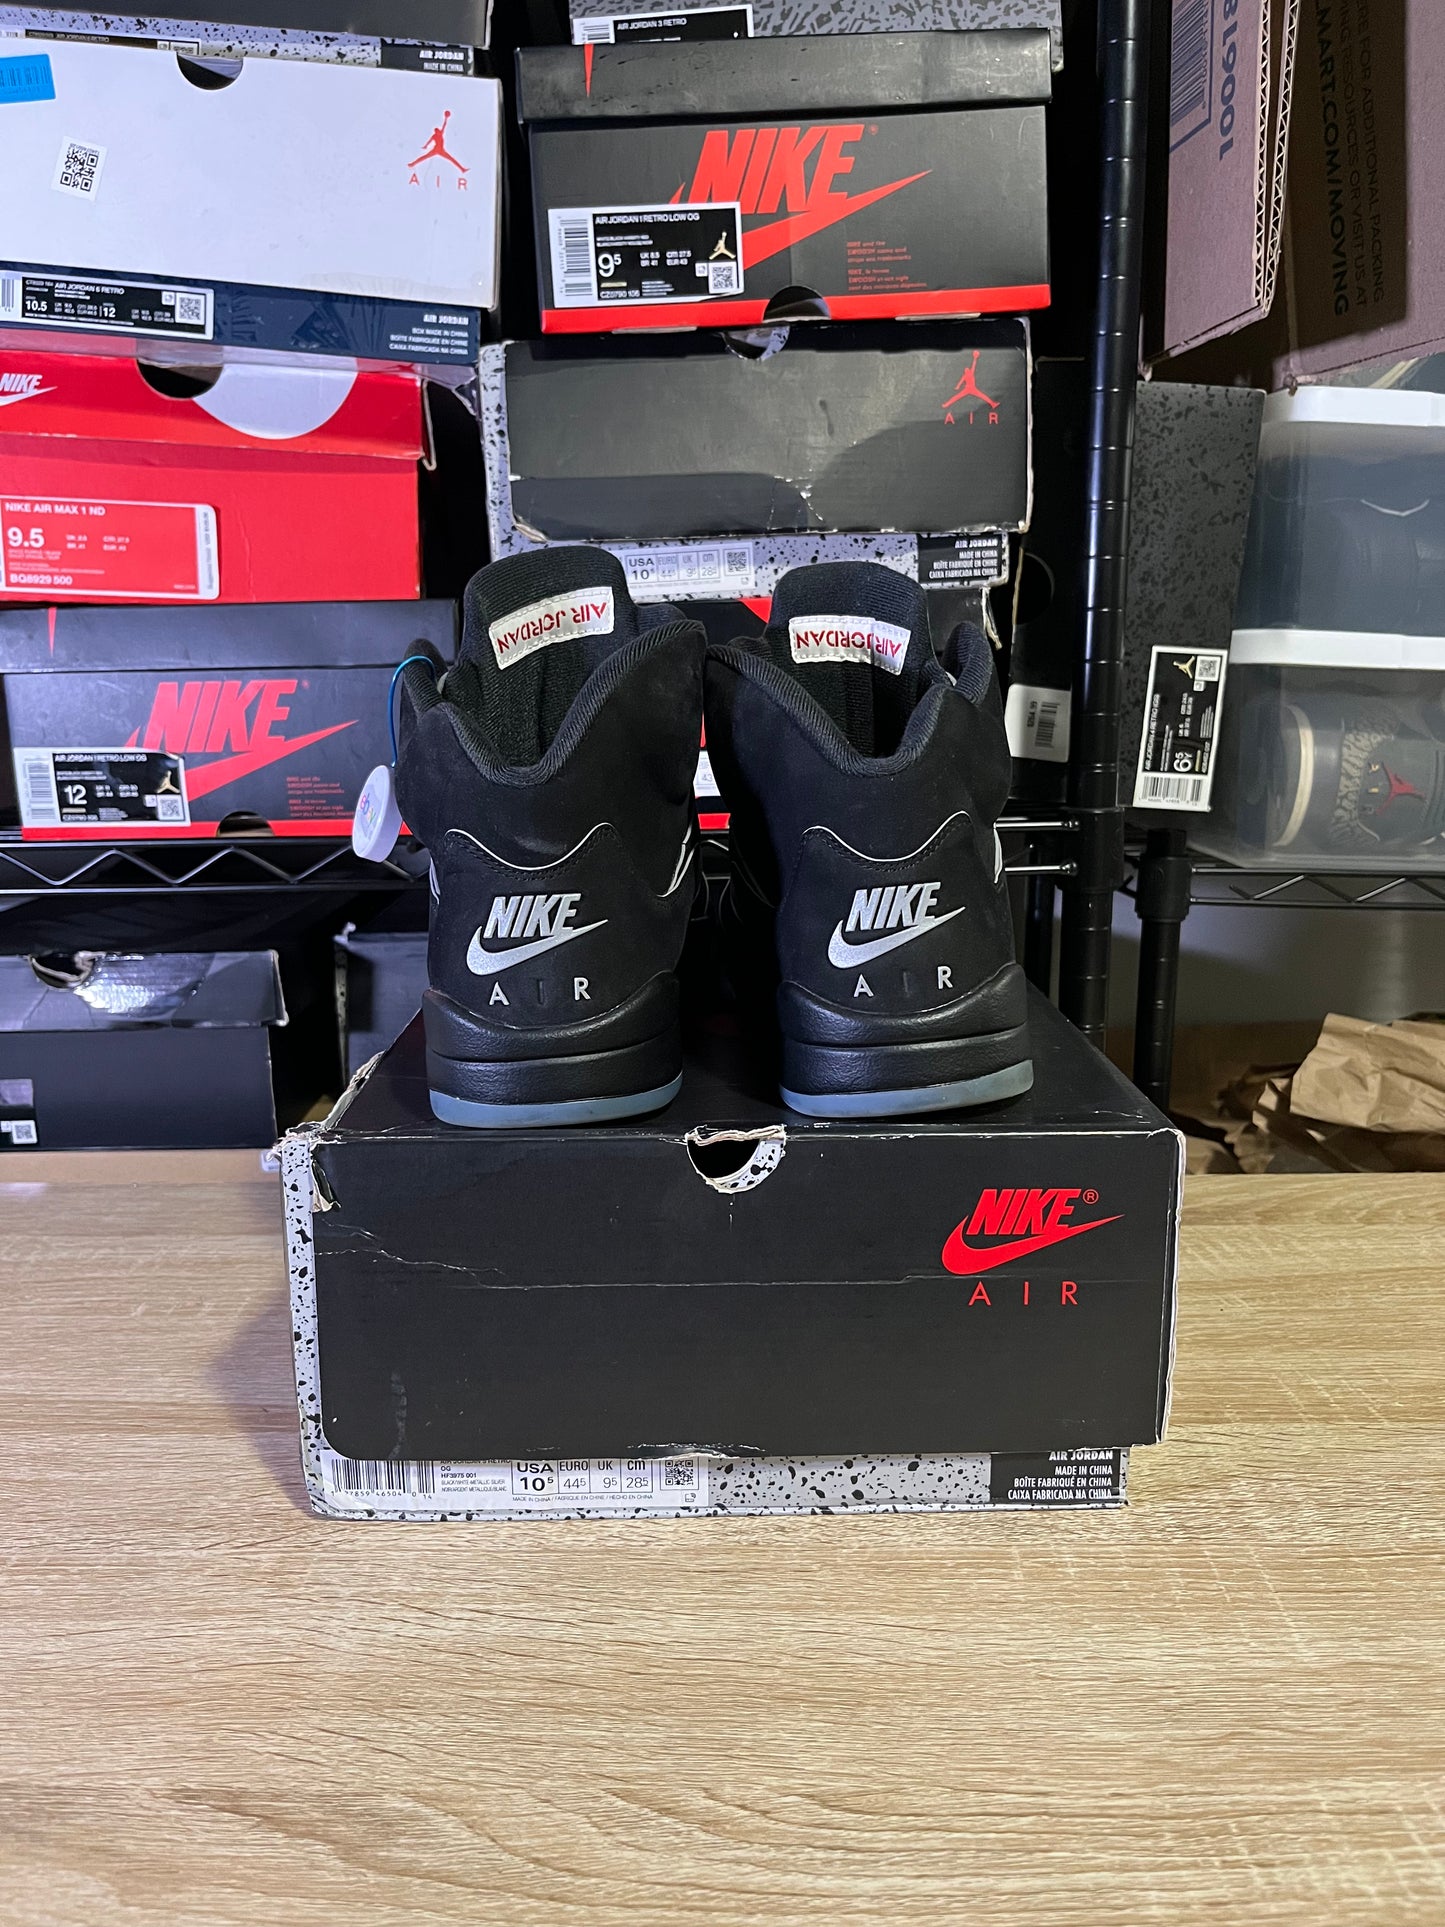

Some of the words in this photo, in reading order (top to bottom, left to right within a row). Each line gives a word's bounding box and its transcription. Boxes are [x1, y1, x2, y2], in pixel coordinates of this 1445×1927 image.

[629, 20, 658, 30] JORDAN
[663, 18, 688, 27] RETRO
[434, 50, 465, 60] JORDAN
[1360, 36, 1372, 80] FOR
[1343, 46, 1359, 166] RESOURCES
[1362, 87, 1379, 211] ADDITIONAL
[687, 123, 865, 214] NIKE
[408, 173, 468, 191] AIR
[1350, 170, 1360, 200] OR
[608, 215, 639, 224] JORDAN
[642, 213, 669, 223] RETRO
[669, 213, 687, 222] LOW
[687, 212, 700, 221] OG
[1352, 202, 1364, 249] VISIT
[1370, 214, 1384, 303] PACKING
[1354, 255, 1366, 282] US
[1356, 286, 1367, 305] AT
[25, 300, 48, 312] 10.5
[103, 307, 116, 318] 12
[0, 373, 43, 392] NIKE
[944, 411, 998, 425] AIR
[5, 502, 31, 512] NIKE
[33, 503, 52, 513] AIR
[54, 504, 79, 515] MAX
[81, 506, 87, 515] 1
[89, 506, 106, 516] ND
[7, 526, 45, 548] 9.5
[955, 540, 968, 549] AIR
[969, 538, 998, 548] JORDAN
[628, 558, 655, 567] USA
[959, 551, 974, 559] MADE
[974, 550, 981, 559] IN
[981, 550, 998, 558] CHINA
[974, 559, 981, 568] EN
[929, 570, 944, 579] CAIXA
[945, 569, 972, 578] FABRICADA
[981, 568, 998, 576] CHINA
[571, 602, 607, 624] AIR
[497, 610, 566, 654] JORDAN
[796, 630, 874, 649] JORDAN
[875, 635, 902, 658] AIR
[143, 679, 298, 753] NIKE
[64, 784, 88, 805] 12
[483, 892, 582, 939] NIKE
[845, 881, 942, 933] NIKE
[966, 1188, 1082, 1236] NIKE
[968, 1280, 1078, 1307] AIR
[1049, 1451, 1068, 1461] AIR
[1070, 1450, 1113, 1460] JORDAN
[516, 1462, 554, 1474] USA
[559, 1460, 588, 1472] EURO
[598, 1460, 613, 1471] UK
[627, 1460, 646, 1471] cm
[1055, 1465, 1077, 1476] MADE
[1078, 1465, 1087, 1475] IN
[1089, 1465, 1113, 1475] CHINA
[1014, 1476, 1036, 1488] BOÎTE
[1037, 1476, 1075, 1487] FABRIQUÉ
[1076, 1478, 1086, 1487] EN
[1088, 1477, 1112, 1487] CHINA
[1007, 1489, 1031, 1500] CAIXA
[1032, 1489, 1073, 1500] FABRICADA
[1075, 1489, 1086, 1499] NA
[1088, 1488, 1112, 1499] CHINA
